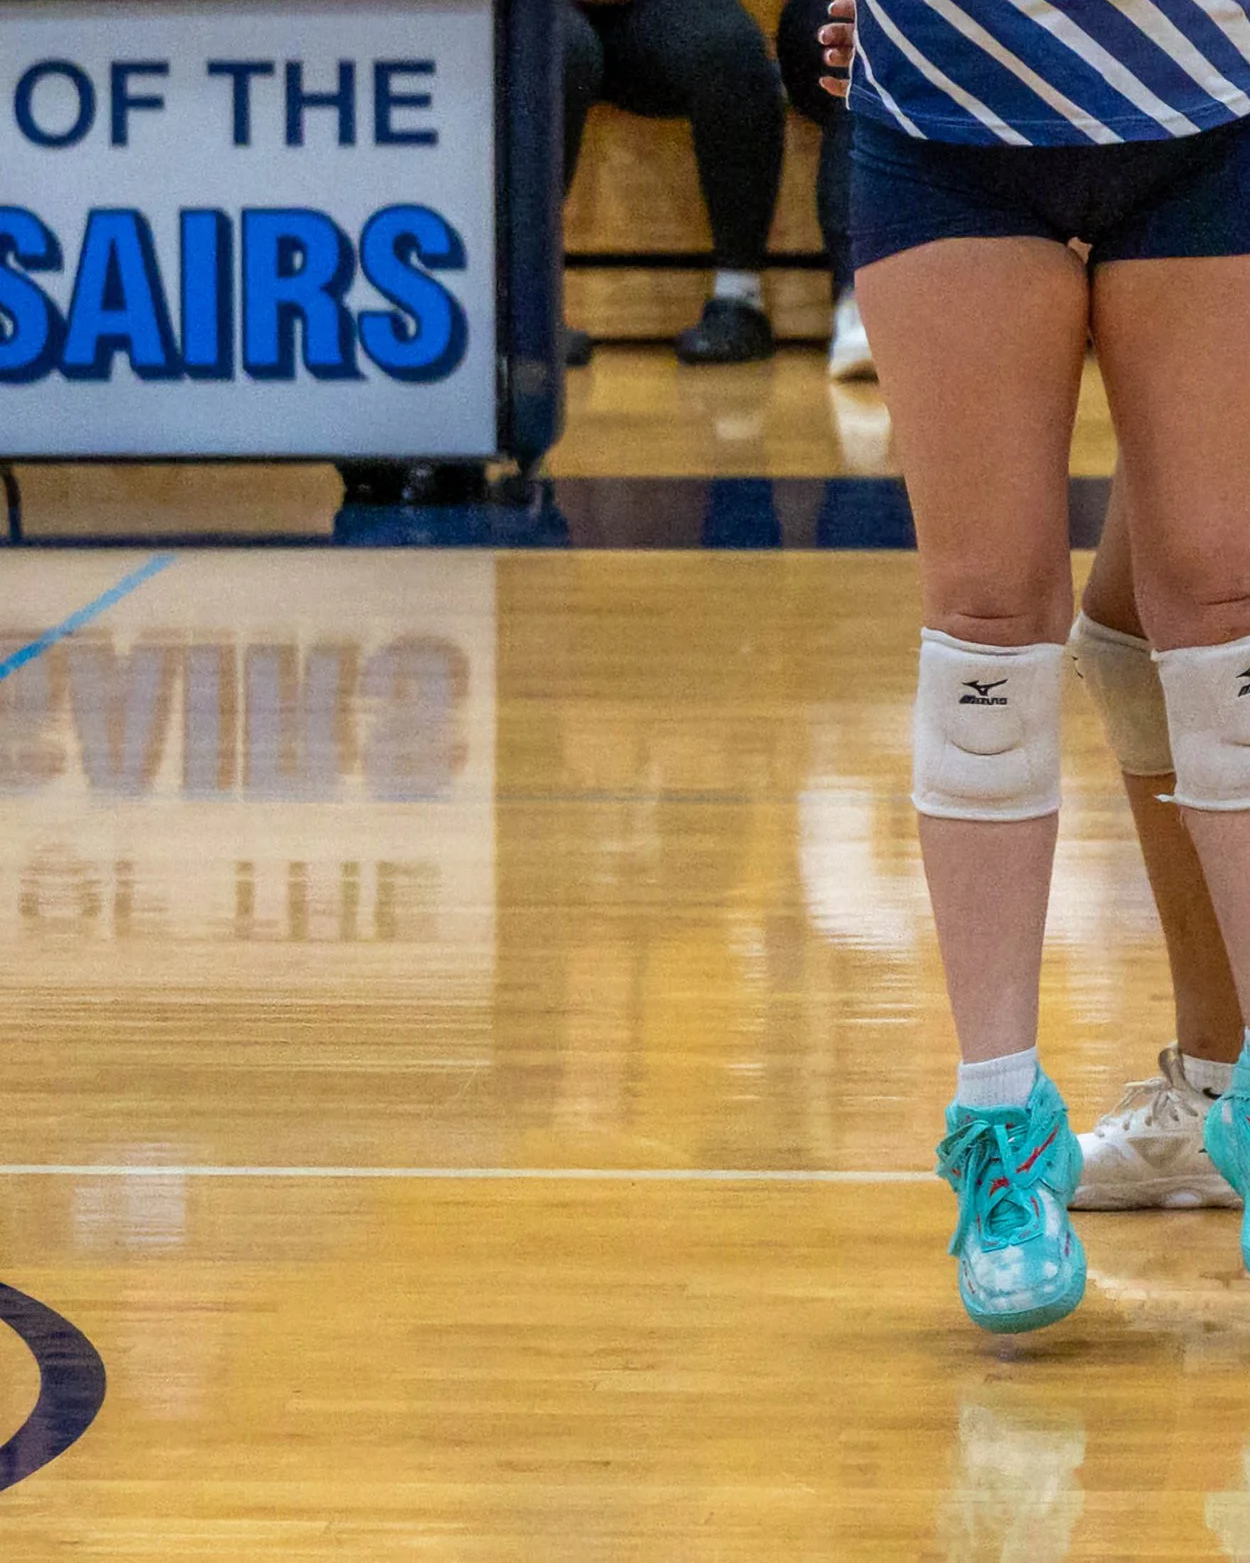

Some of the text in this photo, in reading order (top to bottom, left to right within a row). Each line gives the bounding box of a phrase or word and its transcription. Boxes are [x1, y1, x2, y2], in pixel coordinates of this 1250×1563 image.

[13, 58, 439, 149] OF THE
[0, 203, 470, 384] SAIRS
